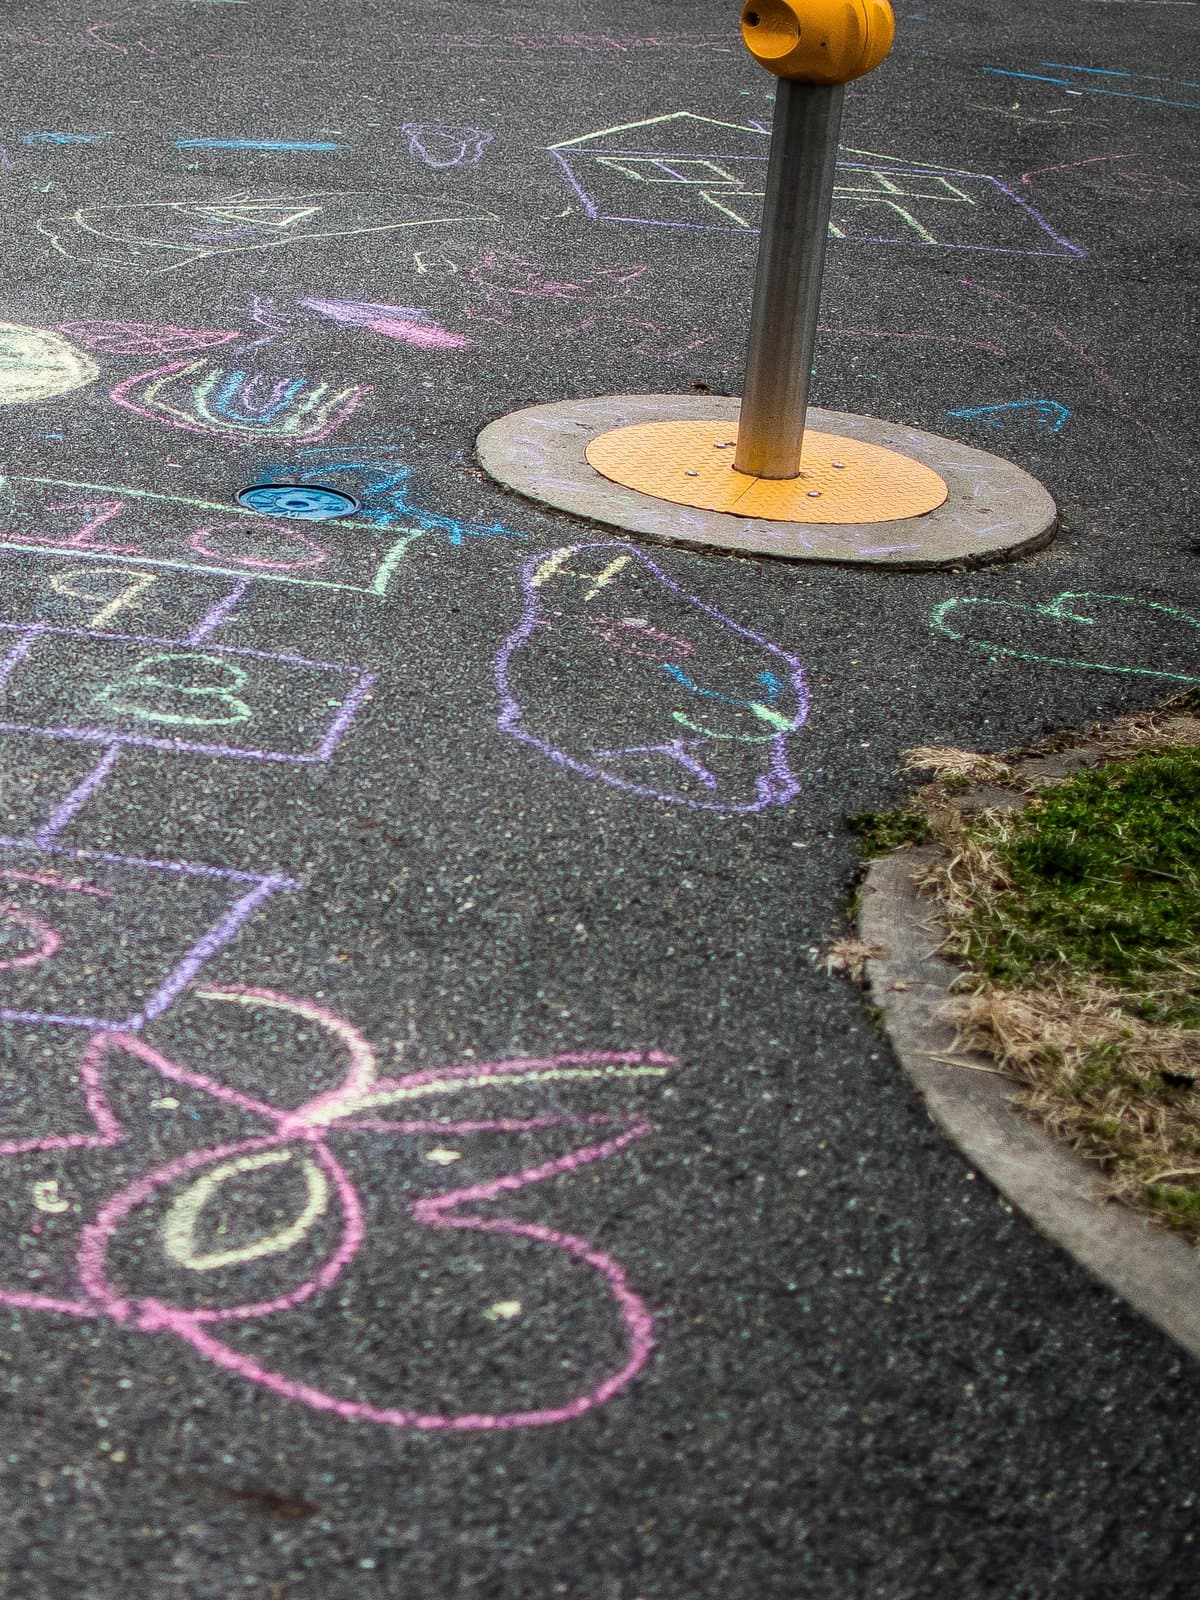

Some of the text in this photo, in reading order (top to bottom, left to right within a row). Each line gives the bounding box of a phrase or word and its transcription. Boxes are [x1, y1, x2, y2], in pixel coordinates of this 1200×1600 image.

[0, 500, 326, 569] 10
[49, 567, 157, 628] 9
[92, 653, 252, 726] 8
